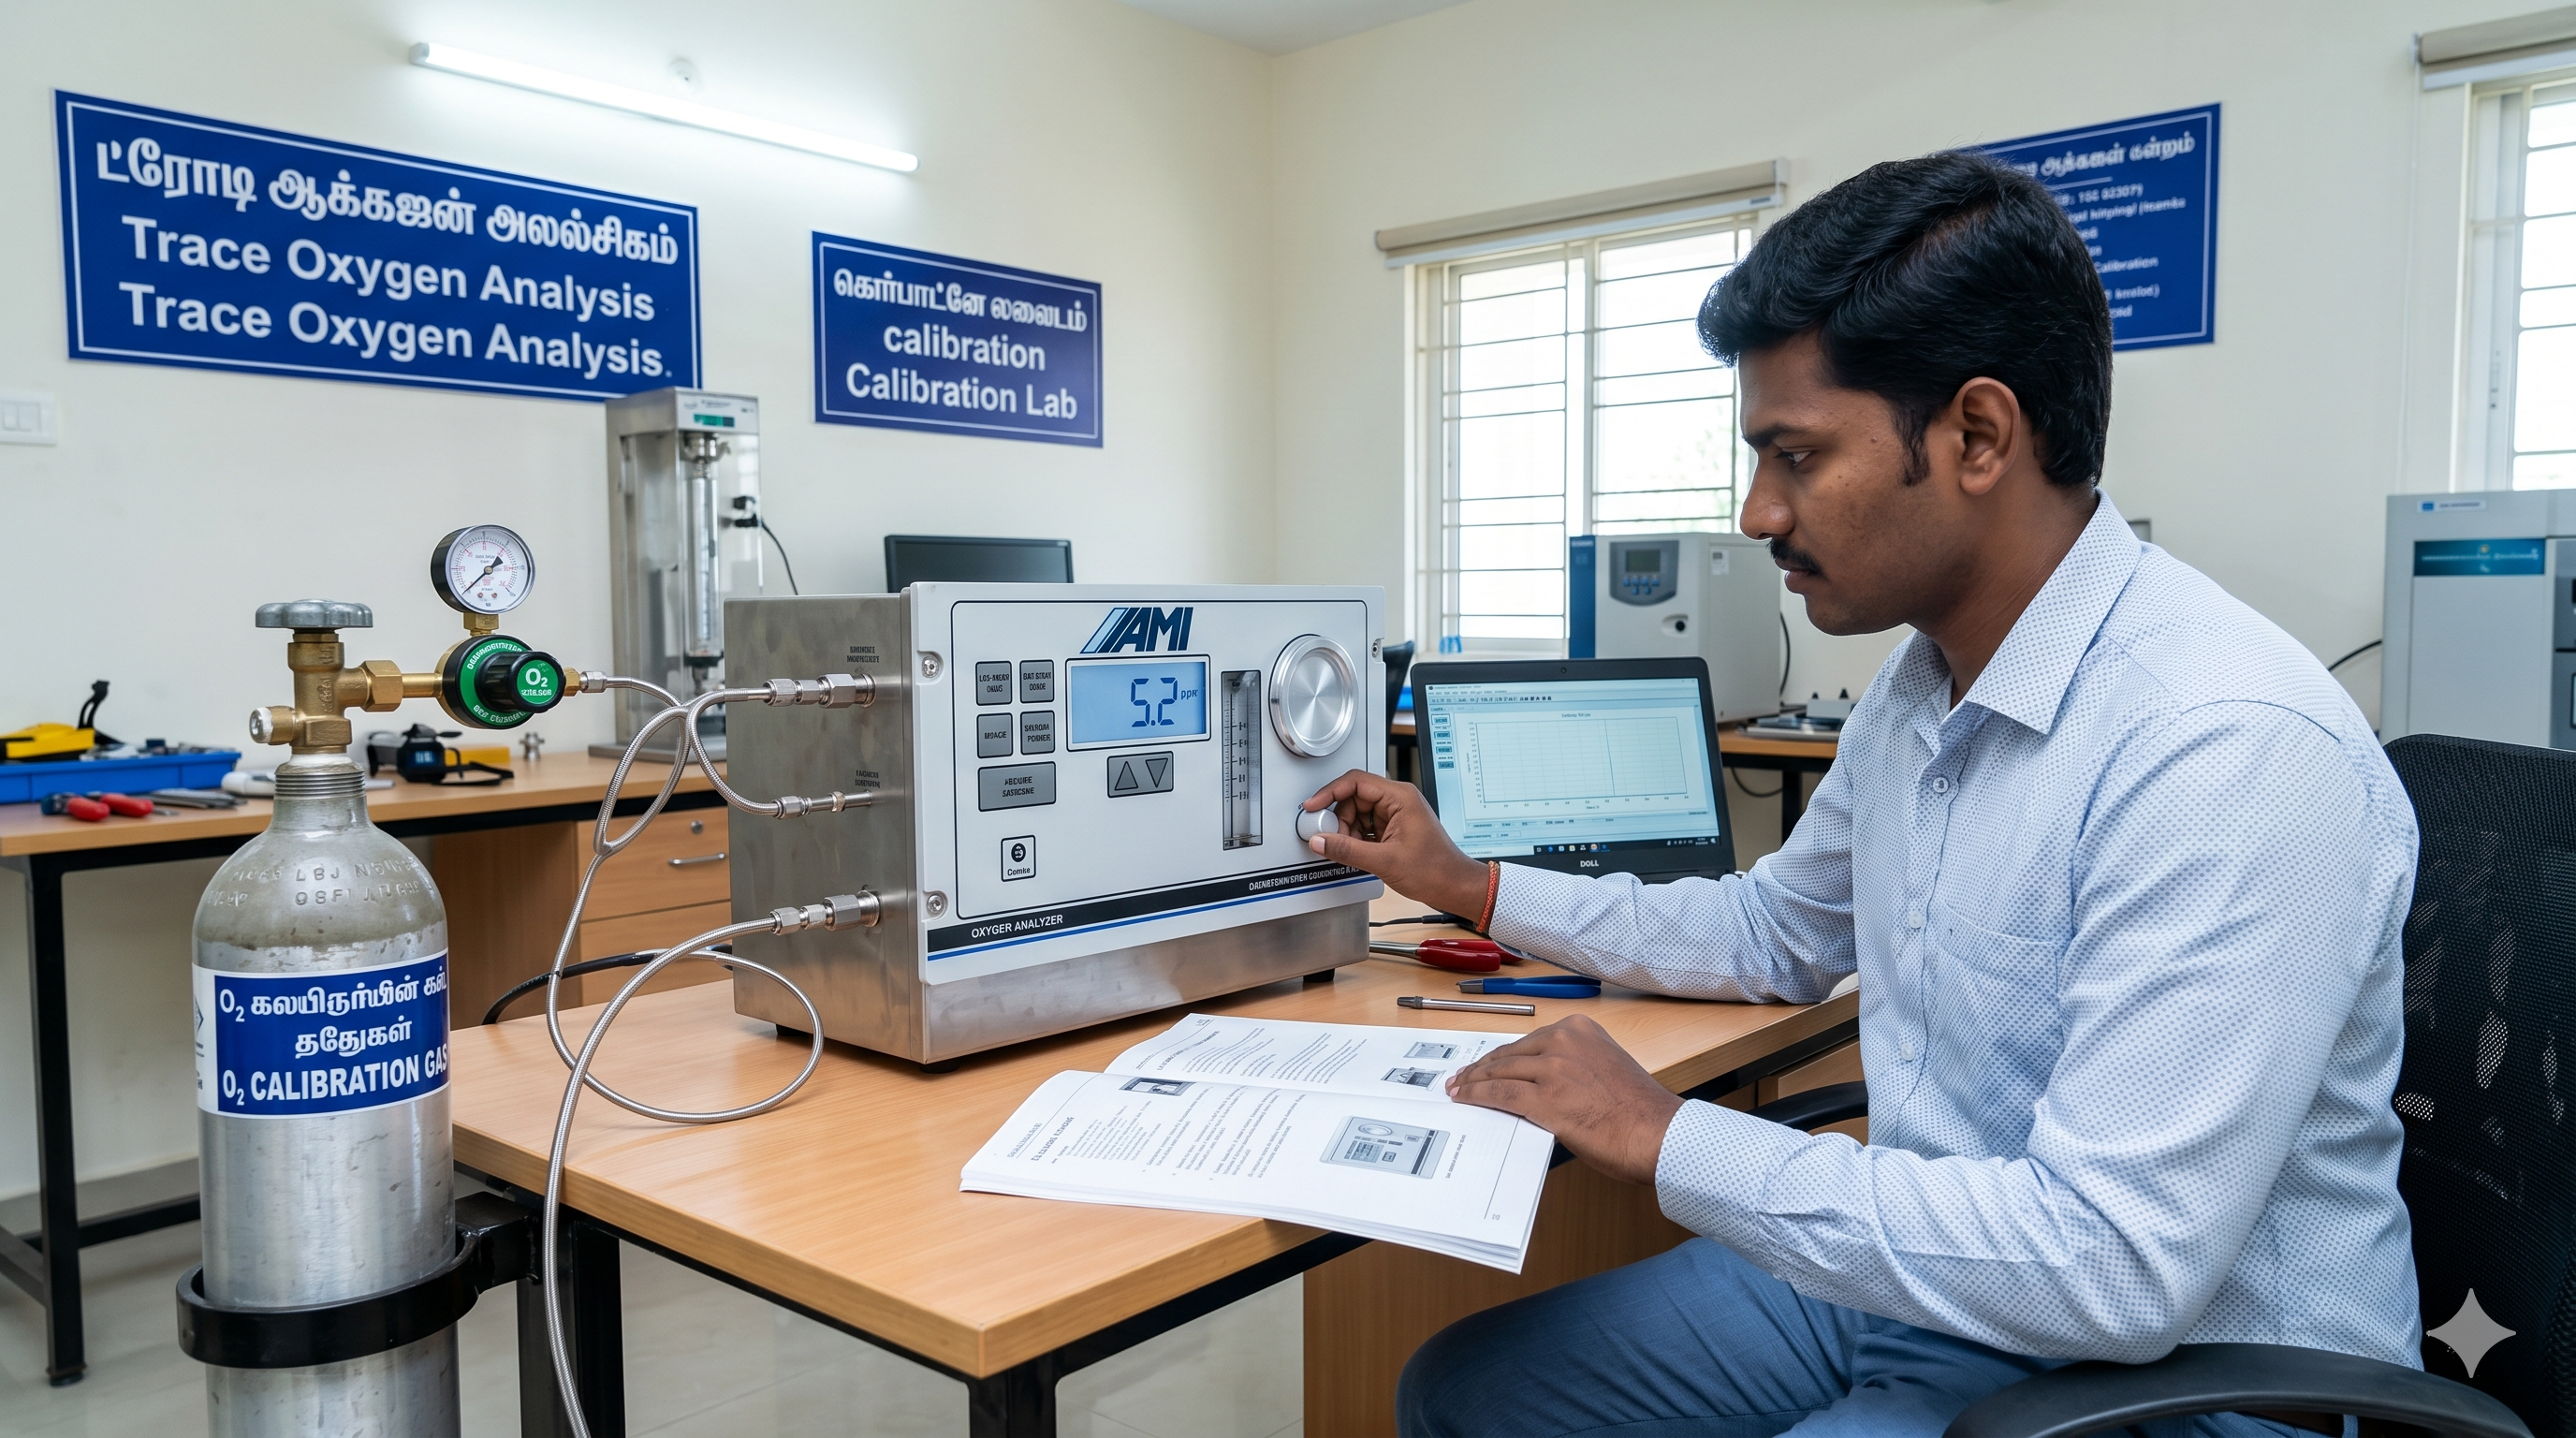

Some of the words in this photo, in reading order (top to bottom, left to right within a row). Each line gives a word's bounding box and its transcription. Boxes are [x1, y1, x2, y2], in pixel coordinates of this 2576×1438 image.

[122, 214, 271, 274] Trace
[287, 238, 468, 301] Oxygen
[479, 264, 655, 322] Analysis
[118, 281, 272, 339] Trace
[288, 301, 473, 363] Oxygen
[883, 323, 1046, 371] calibration
[845, 362, 1017, 413] Calibration
[1026, 383, 1078, 419] Lab
[1097, 607, 1194, 653] AMI
[1130, 677, 1178, 727] 5.2
[1014, 914, 1063, 932] ANALYZER
[250, 1054, 420, 1101] CALIBRATION
[424, 1042, 448, 1079] GAS
